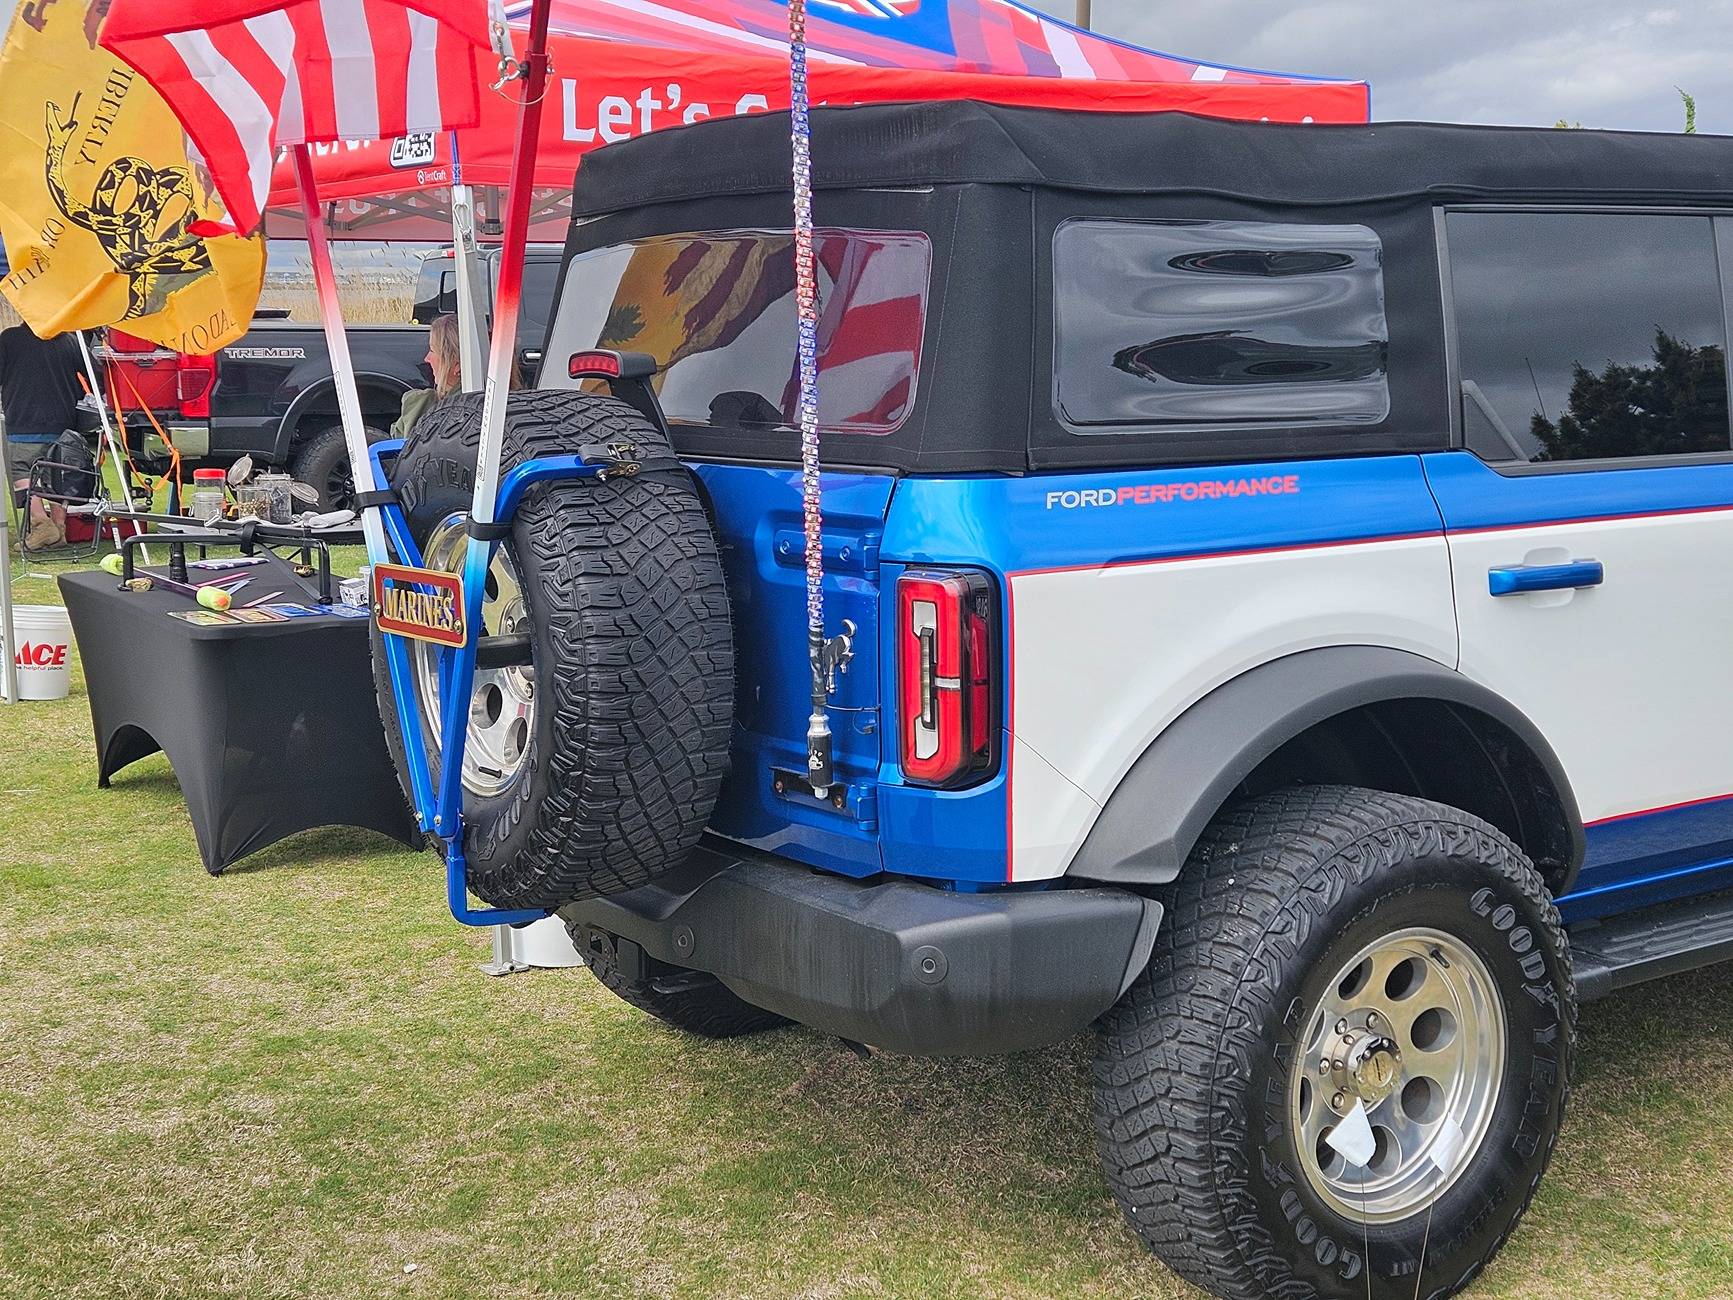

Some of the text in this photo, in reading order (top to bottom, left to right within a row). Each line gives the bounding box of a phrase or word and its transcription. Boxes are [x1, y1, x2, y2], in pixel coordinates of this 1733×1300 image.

[224, 347, 306, 359] TREMOR
[384, 587, 454, 632] MARINES
[15, 640, 67, 665] ACE
